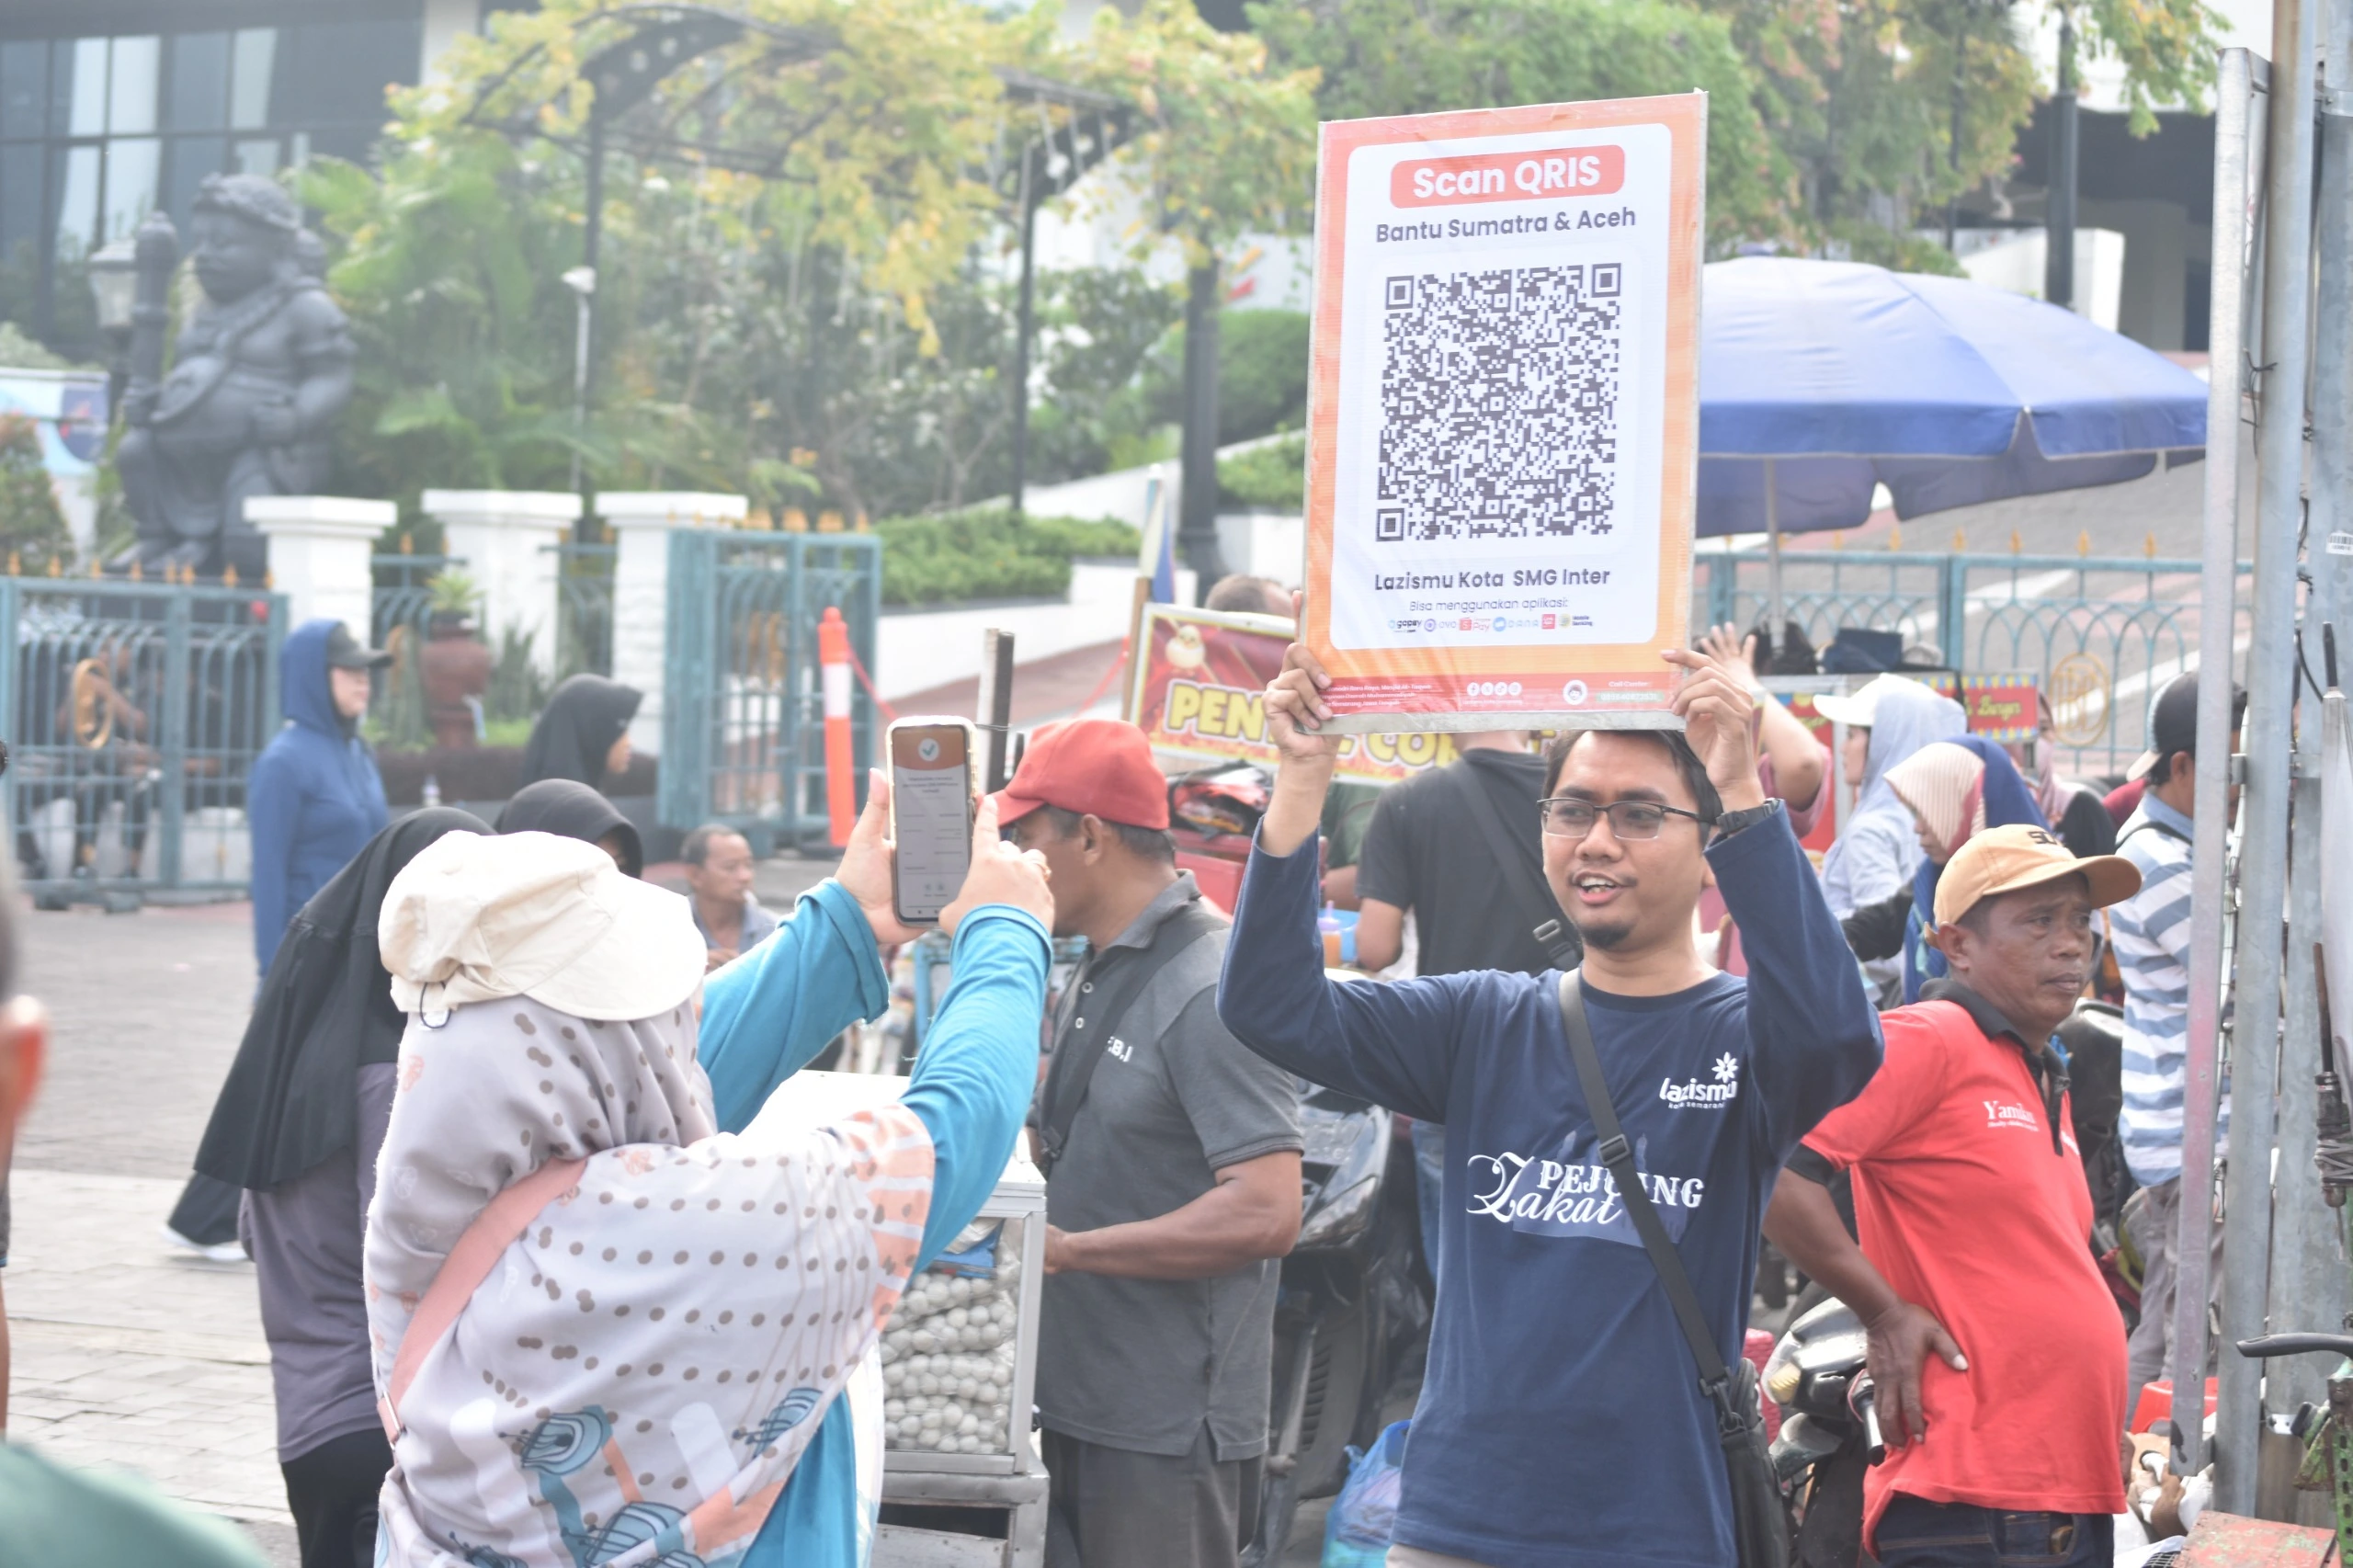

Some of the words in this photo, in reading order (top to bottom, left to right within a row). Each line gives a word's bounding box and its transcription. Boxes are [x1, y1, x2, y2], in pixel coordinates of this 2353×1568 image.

[1413, 167, 1506, 199] Scan
[1514, 155, 1601, 195] QRIS
[1376, 222, 1442, 243] Bantu
[1449, 213, 1548, 238] Sumatra
[1554, 211, 1571, 231] &
[1576, 207, 1636, 229] Aceh
[1375, 571, 1453, 591] Lazismu
[1459, 571, 1504, 588] Kota
[1513, 568, 1558, 586] SMG
[1563, 568, 1610, 585] Inter
[1409, 600, 1433, 612] Bisa
[1436, 598, 1518, 614] menggunakan
[1659, 1077, 1737, 1102] lazismu
[1466, 1151, 1623, 1224] Zakat
